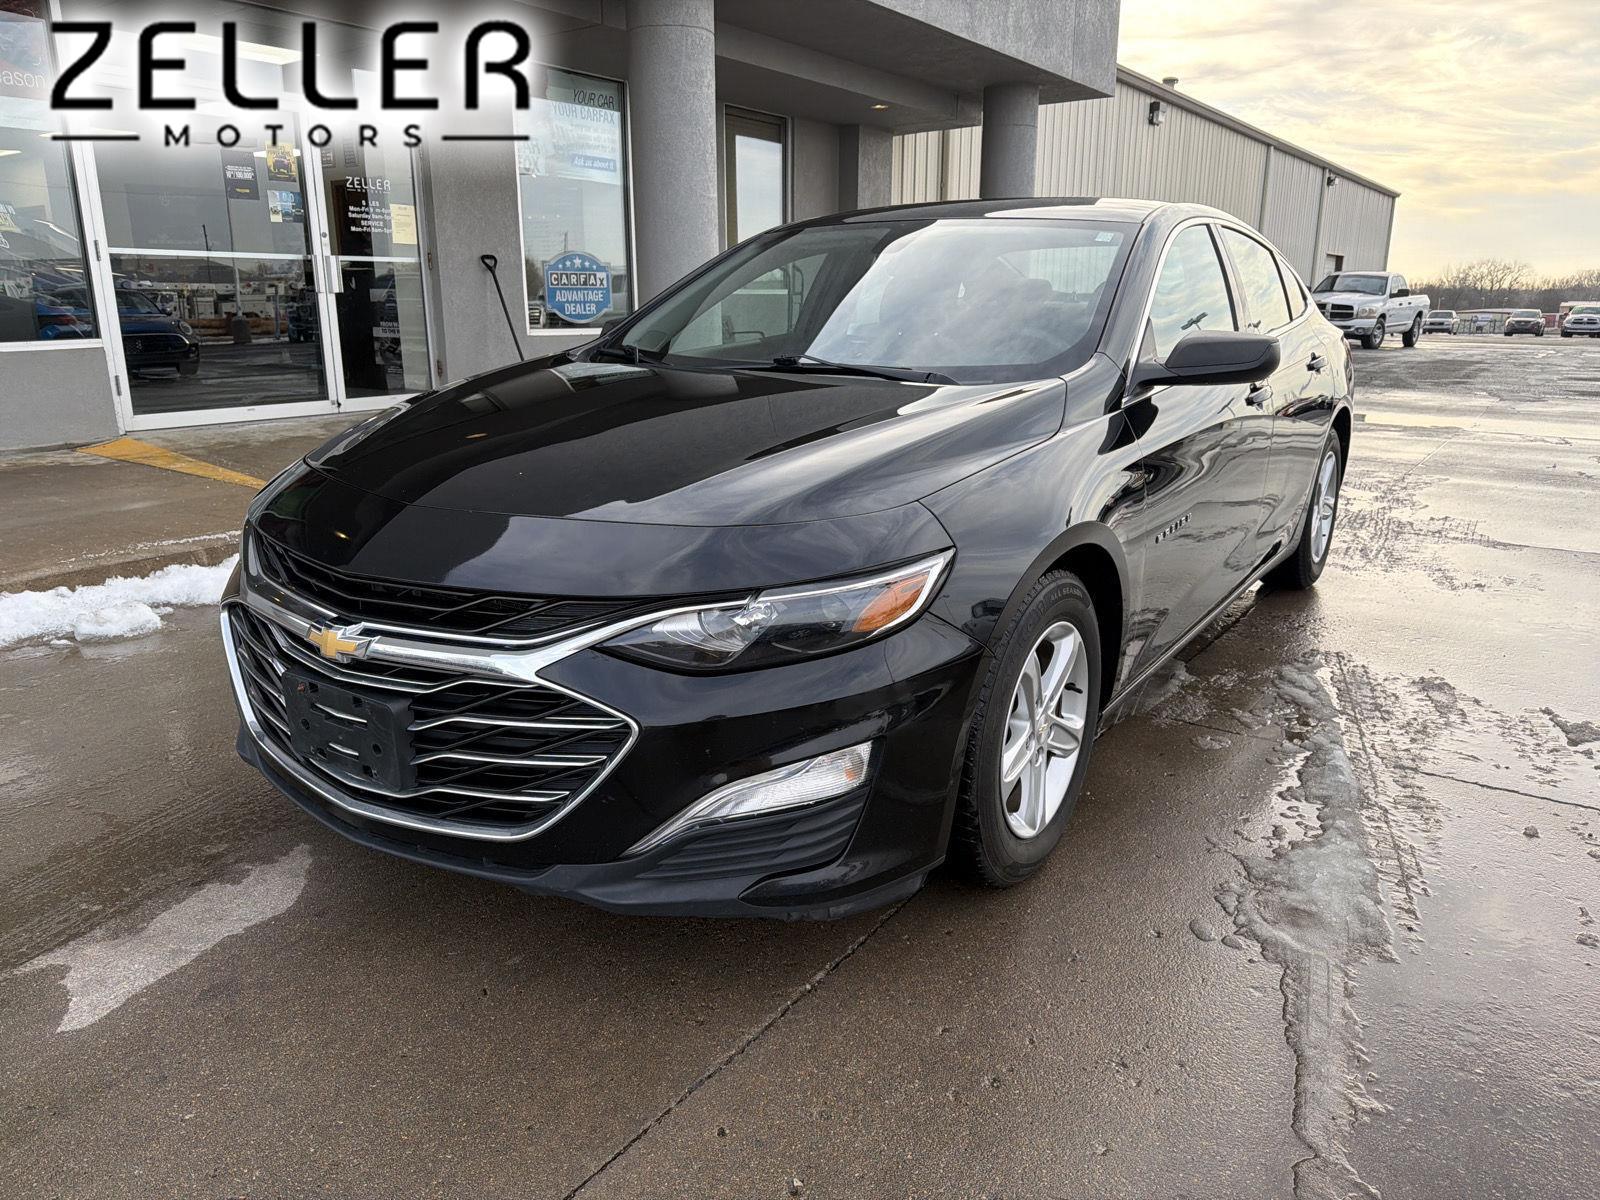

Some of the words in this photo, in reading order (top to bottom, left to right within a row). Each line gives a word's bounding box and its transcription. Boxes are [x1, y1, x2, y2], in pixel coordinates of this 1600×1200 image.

[0, 69, 46, 89] ason
[573, 89, 596, 105] YOUR
[597, 94, 615, 110] CAR
[552, 102, 578, 118] YOUR
[580, 106, 615, 125] CARFAX
[345, 176, 391, 190] ZELLER
[347, 211, 371, 220] Saturday
[551, 273, 605, 288] CARFAX
[564, 303, 597, 315] DEALER
